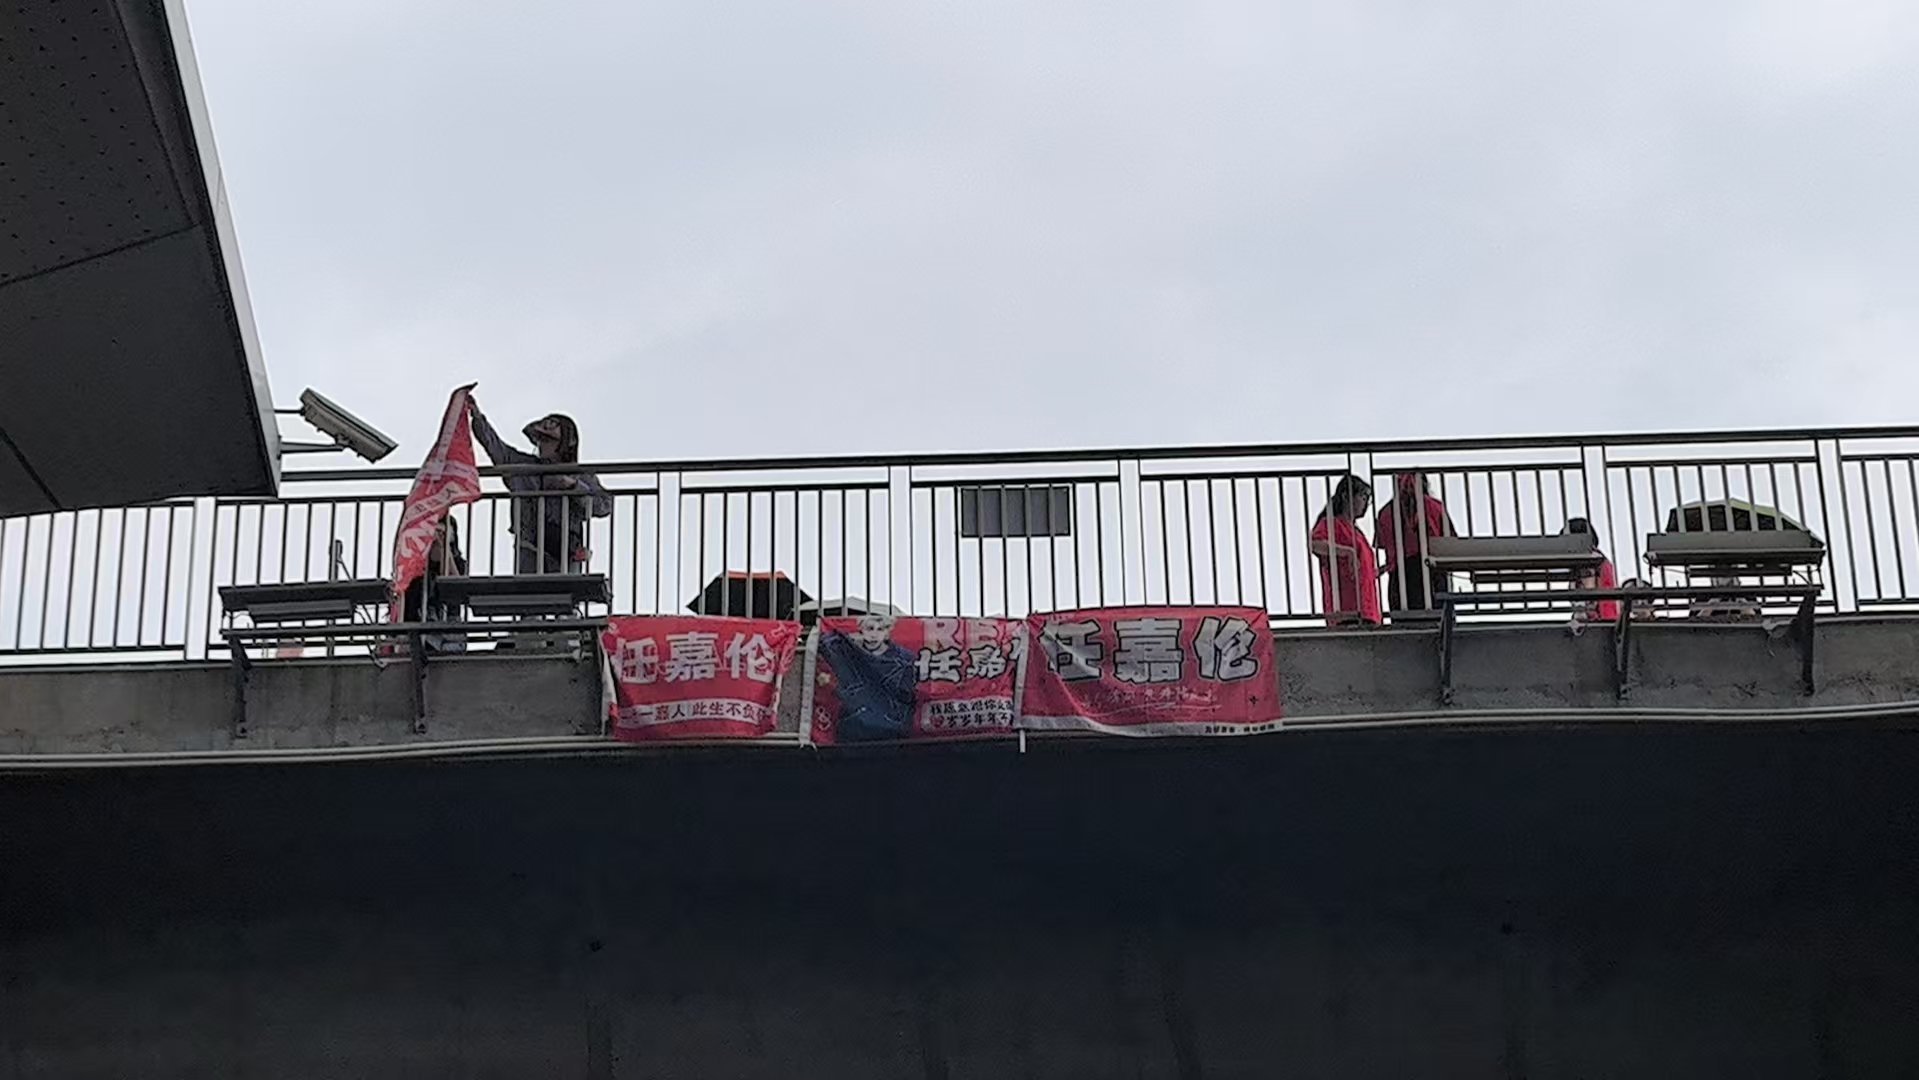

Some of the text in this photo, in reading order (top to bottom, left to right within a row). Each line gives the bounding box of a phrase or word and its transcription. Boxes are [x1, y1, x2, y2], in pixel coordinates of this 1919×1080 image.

[610, 631, 776, 684] 任嘉伦
[1038, 616, 1258, 684] 任嘉伦
